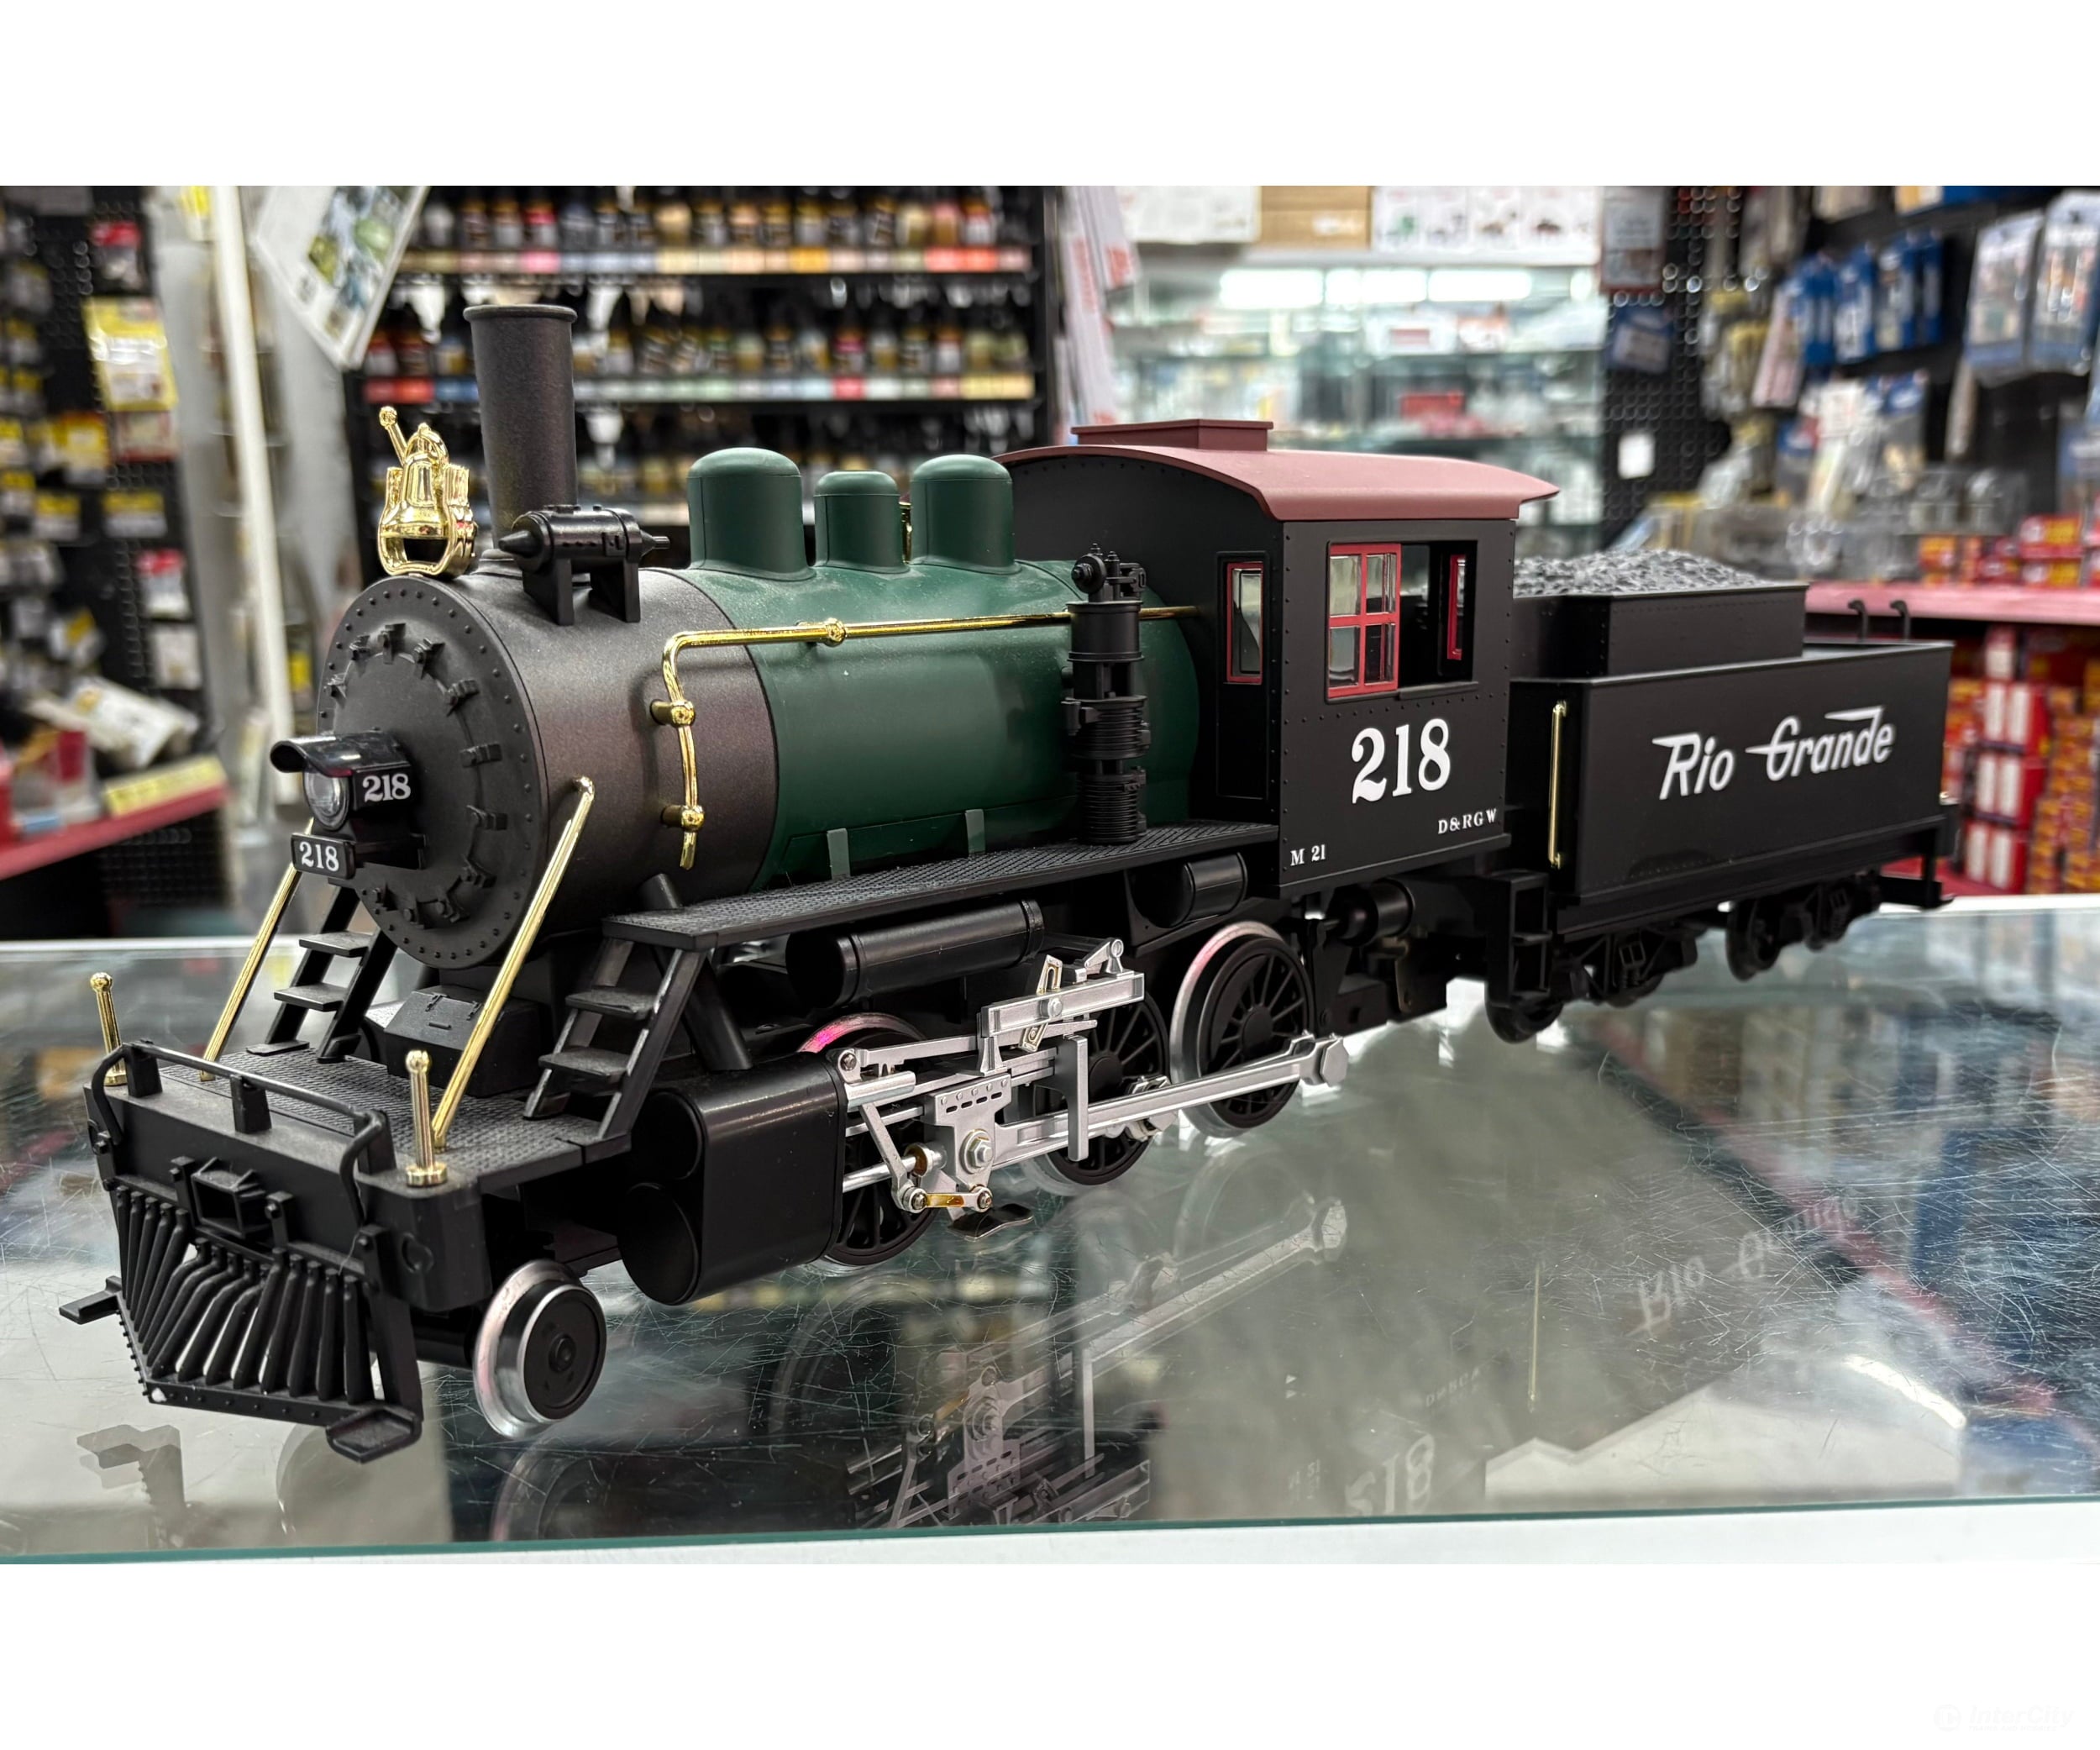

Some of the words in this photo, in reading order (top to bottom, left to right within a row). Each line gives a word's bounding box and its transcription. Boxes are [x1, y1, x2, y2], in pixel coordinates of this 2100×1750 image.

[1352, 718, 1451, 804] 218
[1652, 732, 1735, 800] Rio
[1745, 705, 1895, 781] Grande
[362, 773, 412, 802] 218
[299, 841, 339, 872] 218
[1290, 848, 1305, 866] M
[1311, 844, 1326, 861] 21
